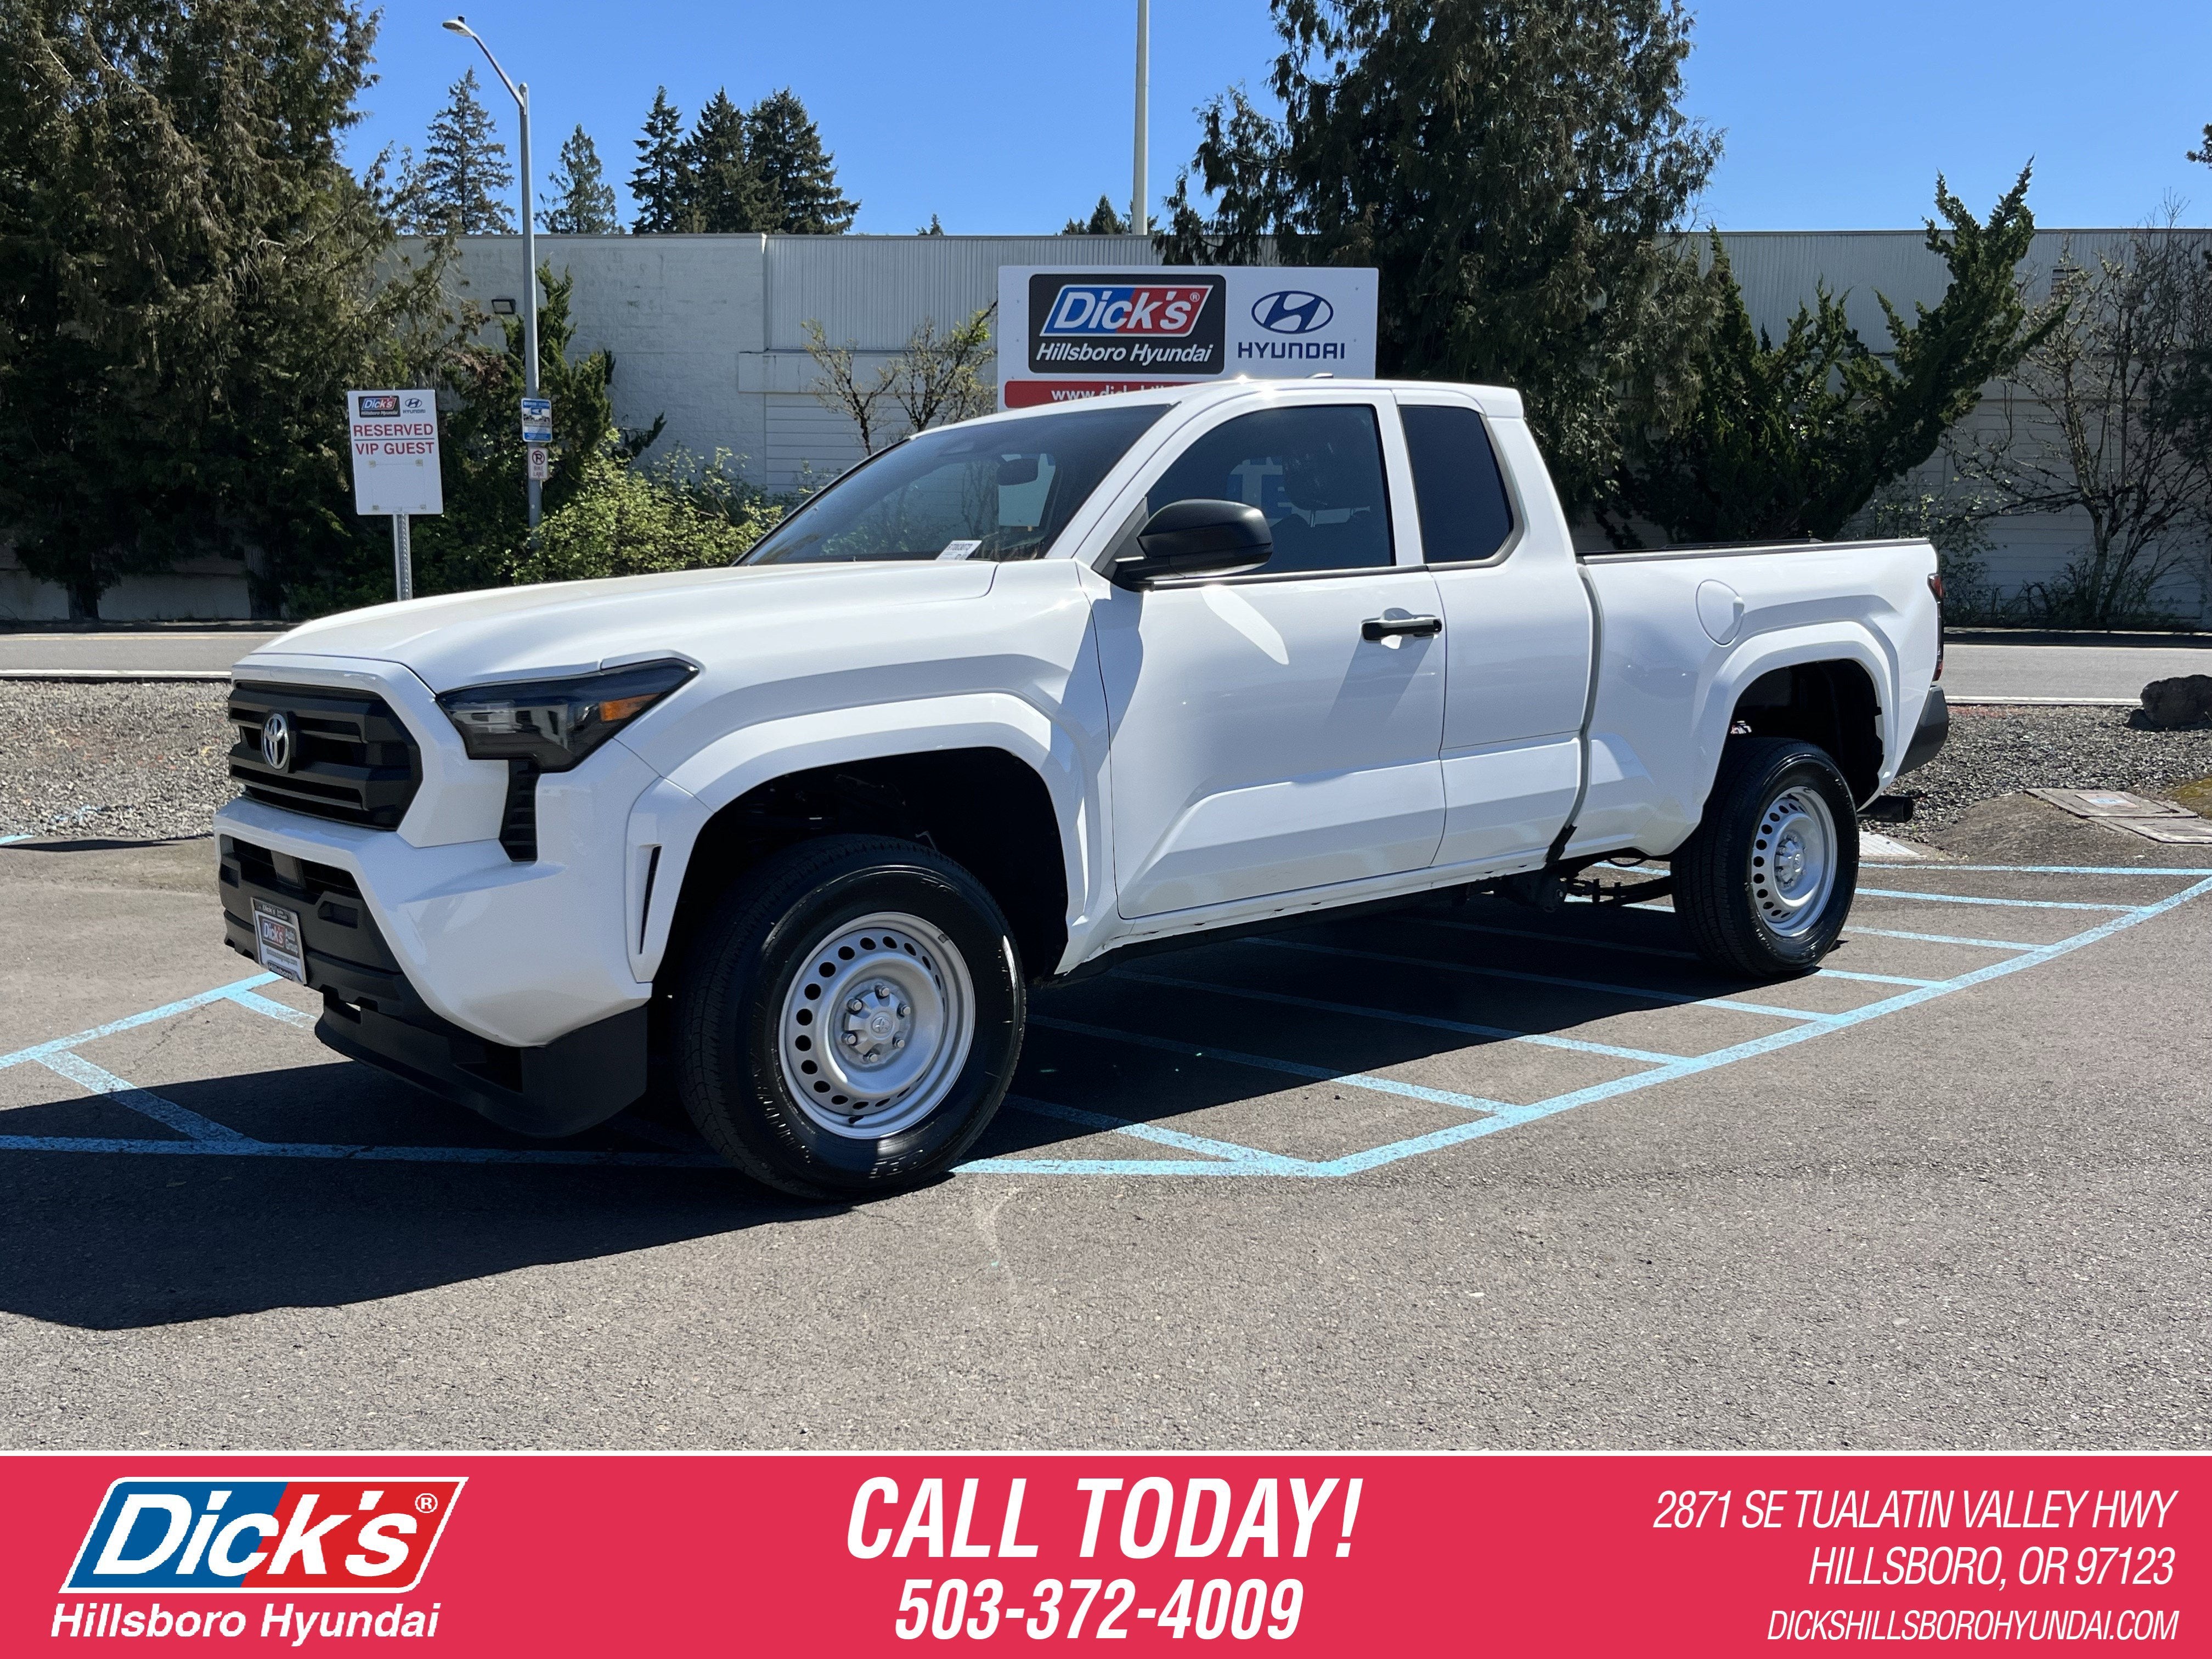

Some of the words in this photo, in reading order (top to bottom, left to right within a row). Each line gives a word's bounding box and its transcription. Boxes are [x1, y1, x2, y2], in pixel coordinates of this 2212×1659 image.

[1036, 343, 1126, 362] Hillsboro
[1129, 344, 1214, 366] Hyundai
[1238, 341, 1346, 360] HYUNDAI
[353, 423, 434, 437] RESERVED
[355, 443, 379, 455] VIP
[384, 442, 435, 455] GUEST
[263, 922, 284, 945] Dick's
